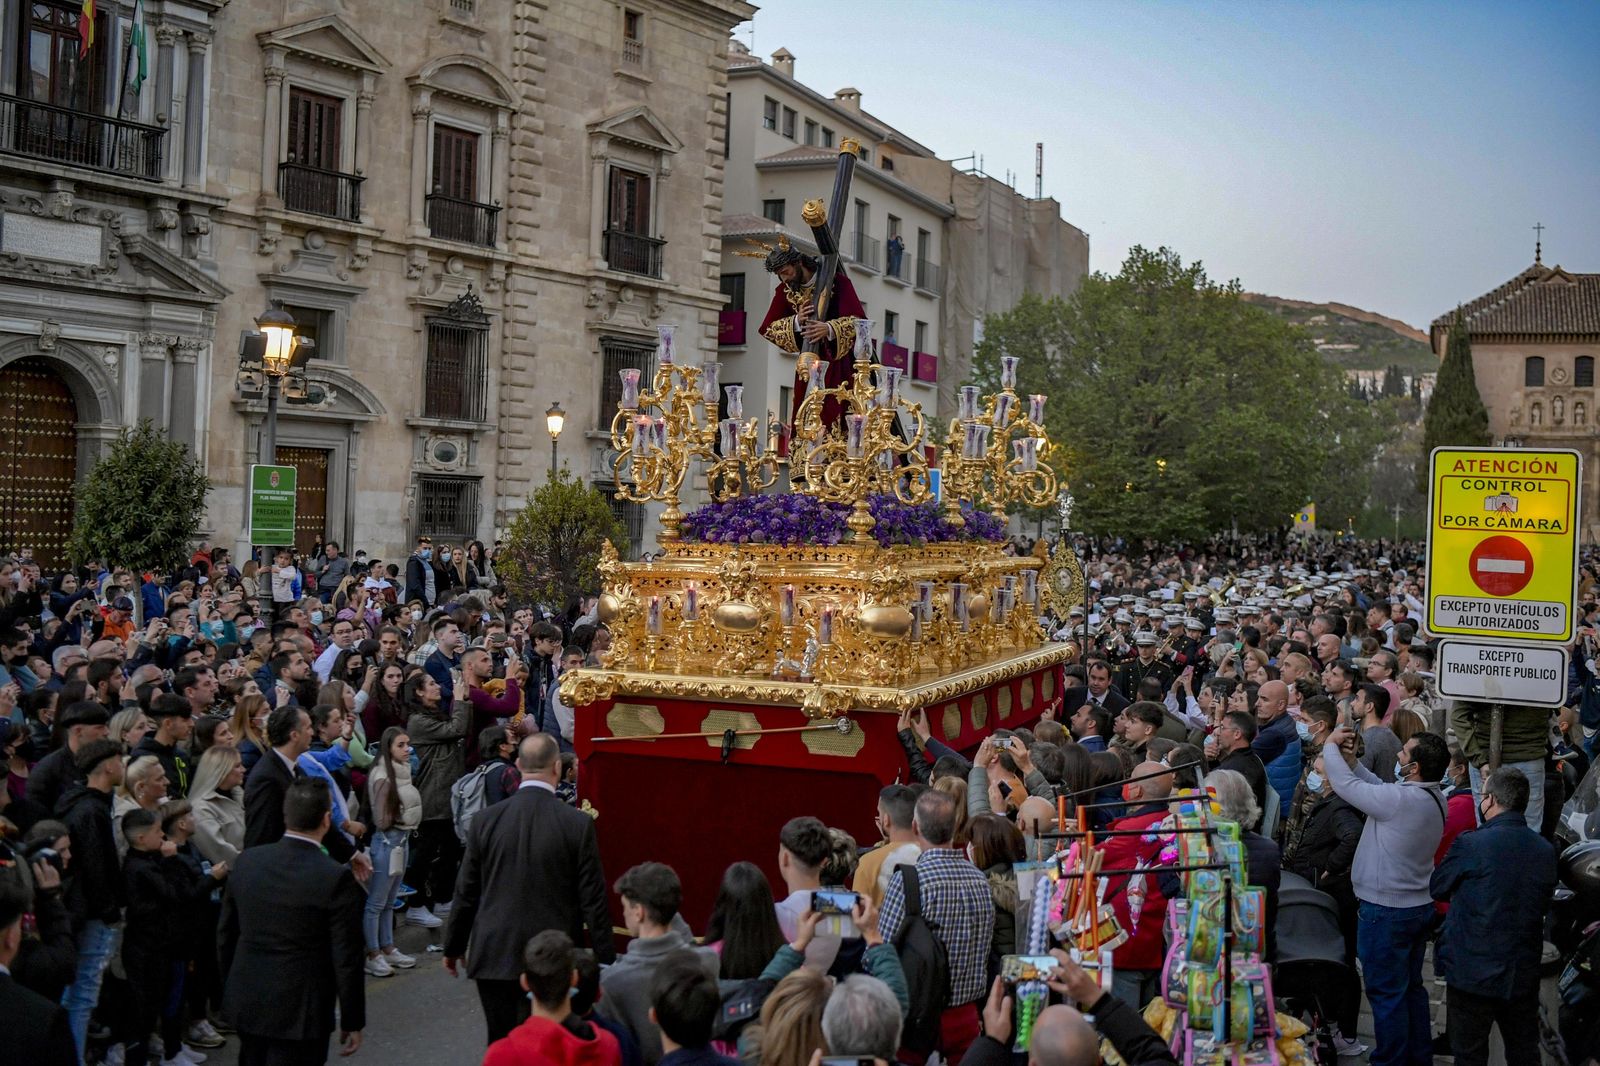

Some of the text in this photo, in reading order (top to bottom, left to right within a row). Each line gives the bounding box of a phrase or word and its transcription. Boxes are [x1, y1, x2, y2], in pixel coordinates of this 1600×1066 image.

[1453, 457, 1558, 474] ATENCIÓN
[1461, 479, 1547, 492] CONTROL
[1443, 515, 1479, 527] POR
[1440, 600, 1560, 618] EXCEPTO VEHÍCULOS
[1457, 615, 1540, 631] AUTORIZADOS
[1479, 650, 1524, 664] EXCEPTO
[1447, 662, 1557, 681] TRANSPORTE PUBLICO
